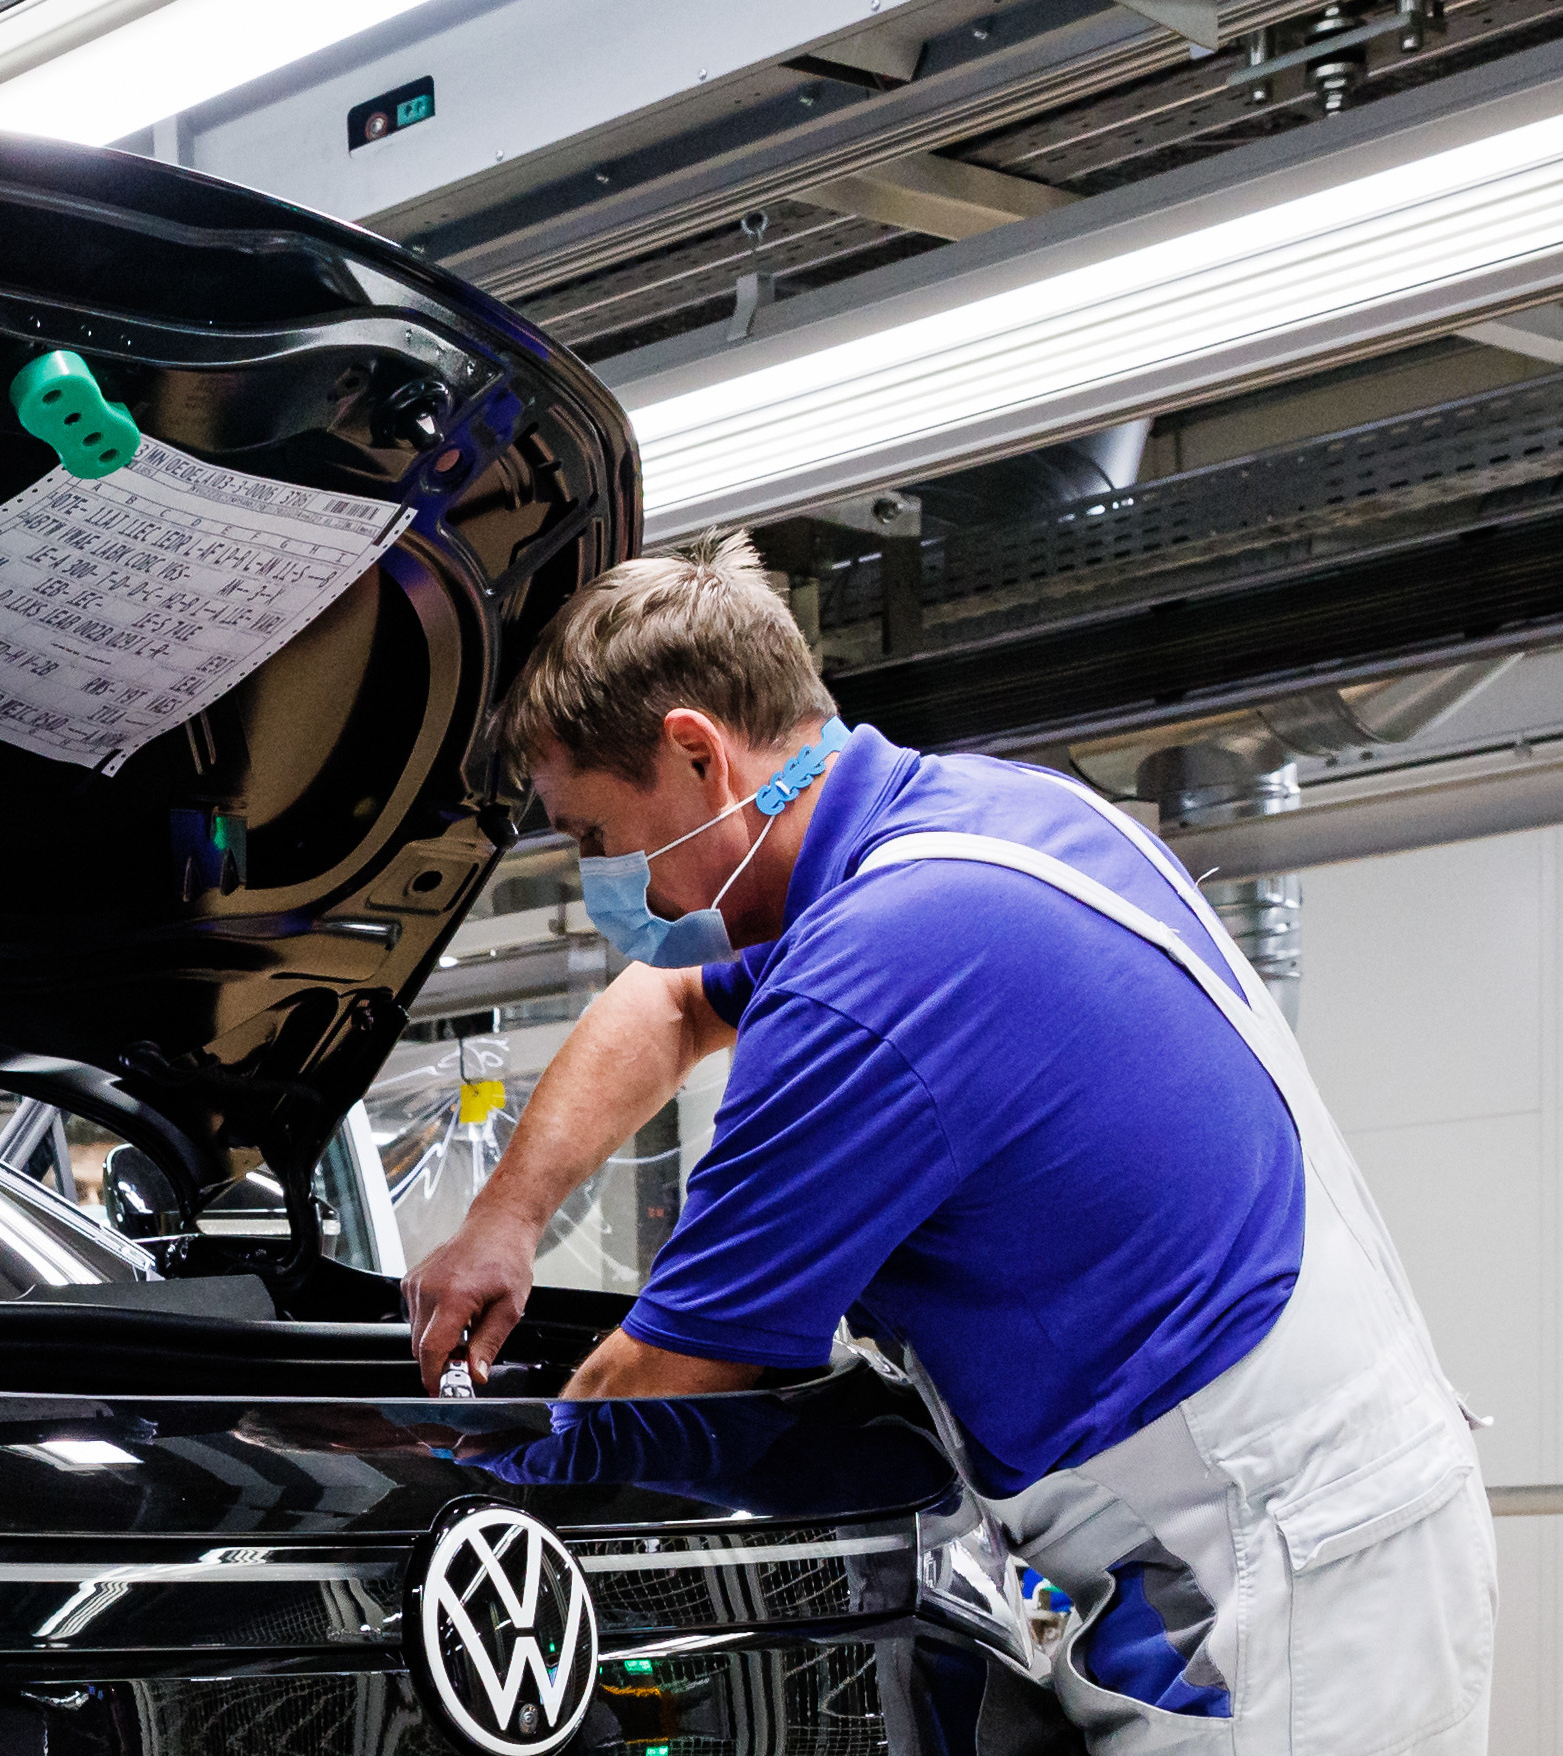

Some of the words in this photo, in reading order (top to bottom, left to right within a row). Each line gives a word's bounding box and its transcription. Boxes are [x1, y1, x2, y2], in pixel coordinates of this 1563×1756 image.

[92, 483, 102, 492] A
[125, 496, 137, 504] B
[160, 509, 171, 517] C
[221, 526, 234, 534] E
[251, 532, 261, 540] F
[280, 540, 290, 549] G
[429, 1513, 595, 1748] VW
